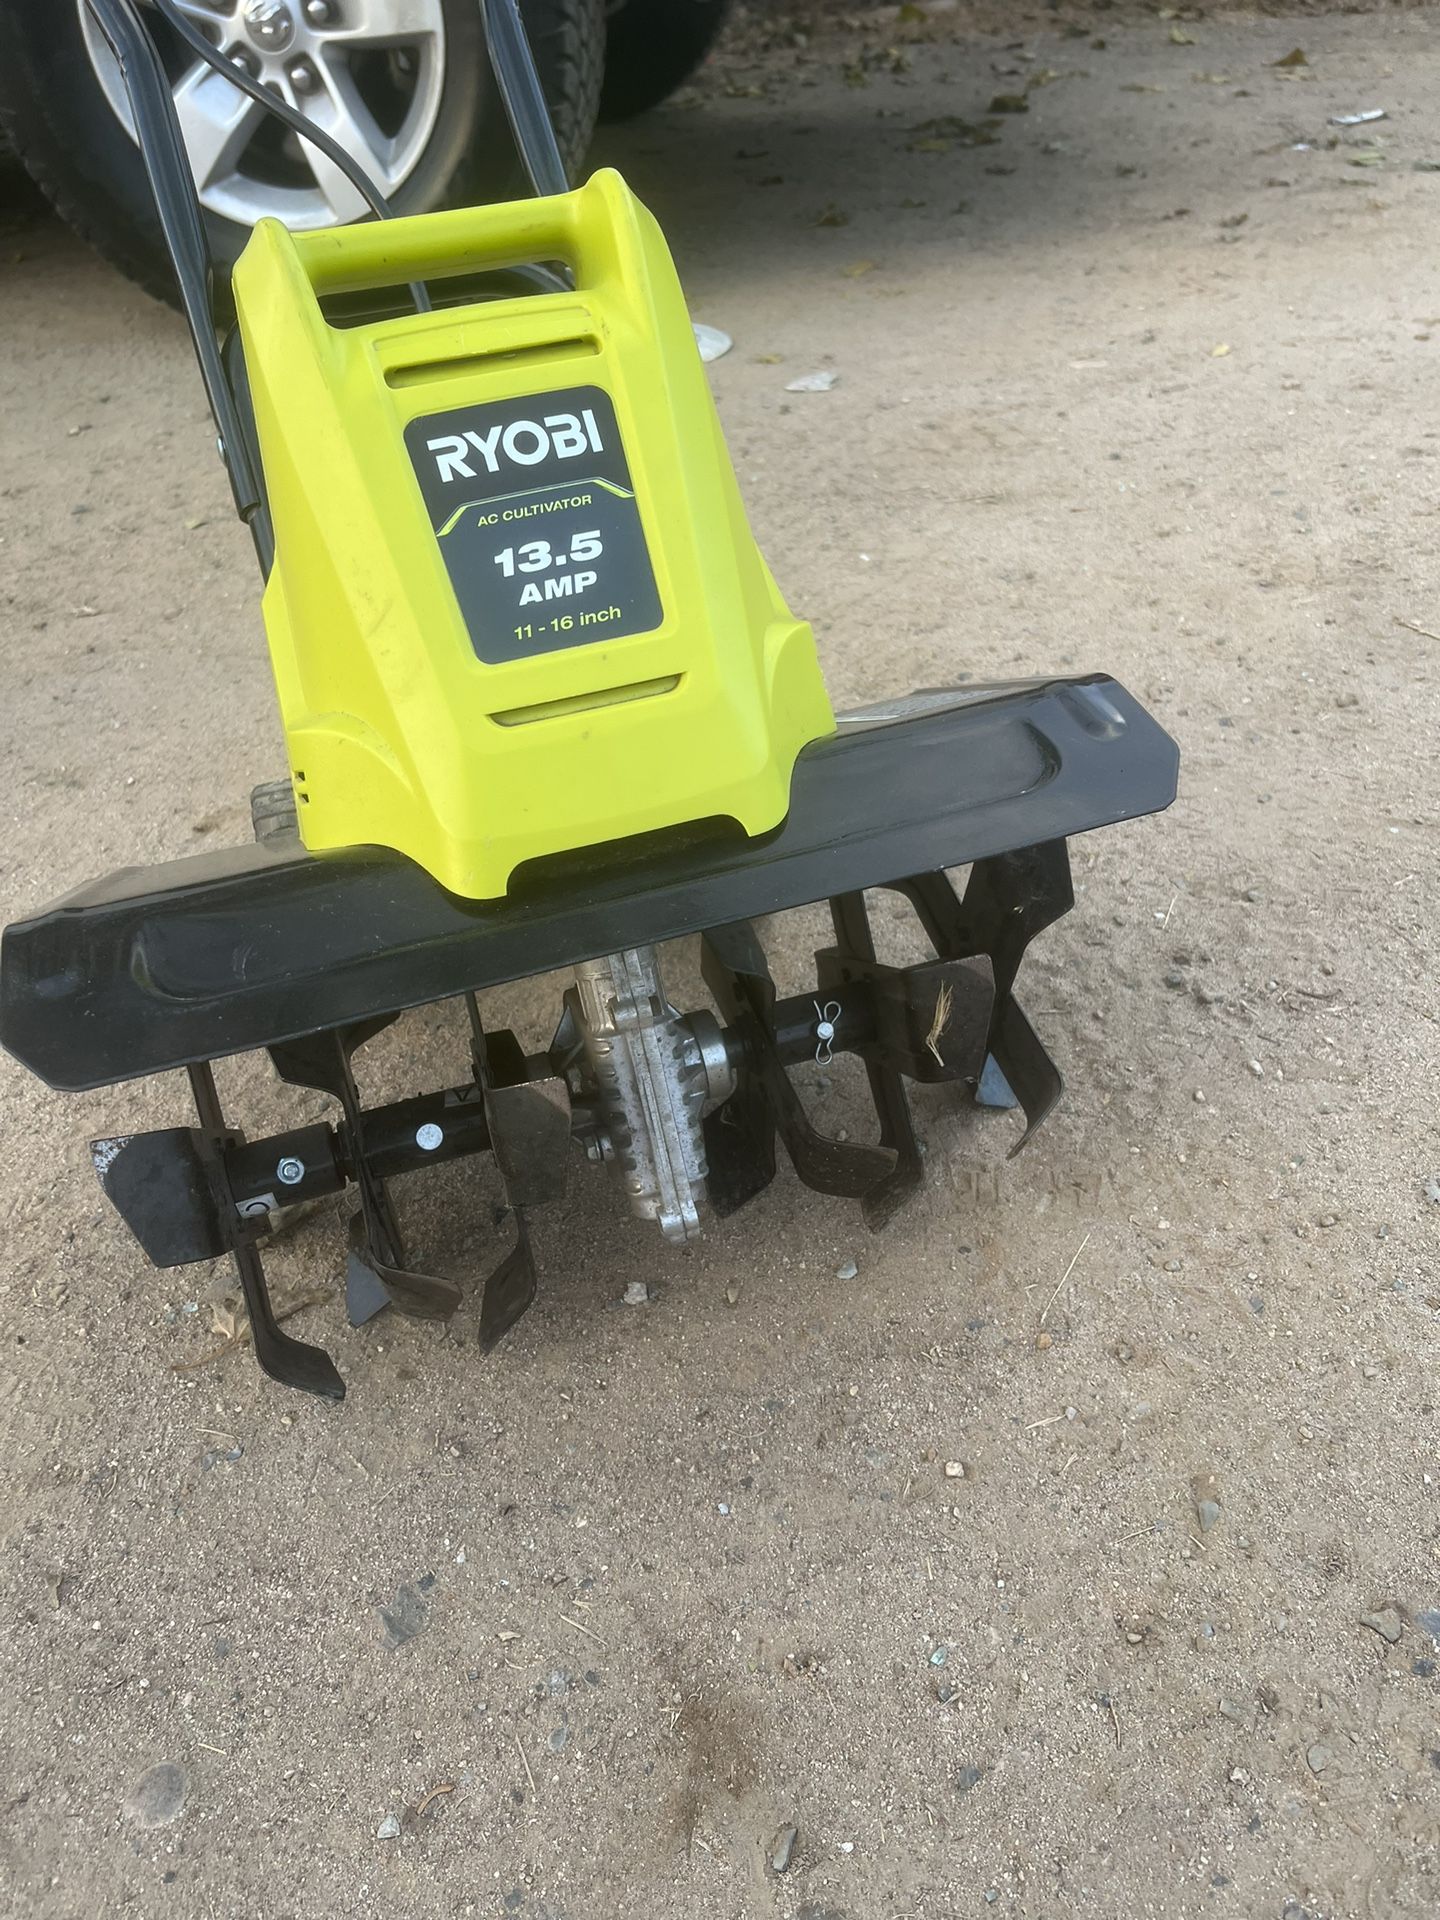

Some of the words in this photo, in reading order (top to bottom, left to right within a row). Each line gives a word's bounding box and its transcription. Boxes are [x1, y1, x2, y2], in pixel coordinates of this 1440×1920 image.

[426, 409, 604, 483] RYOBI
[477, 513, 499, 527] AC
[502, 494, 592, 522] CULTIVATOR
[494, 529, 603, 578] 13.5
[518, 570, 598, 607] AMP
[514, 624, 533, 640] 11
[550, 615, 574, 632] 16
[579, 606, 622, 627] inch
